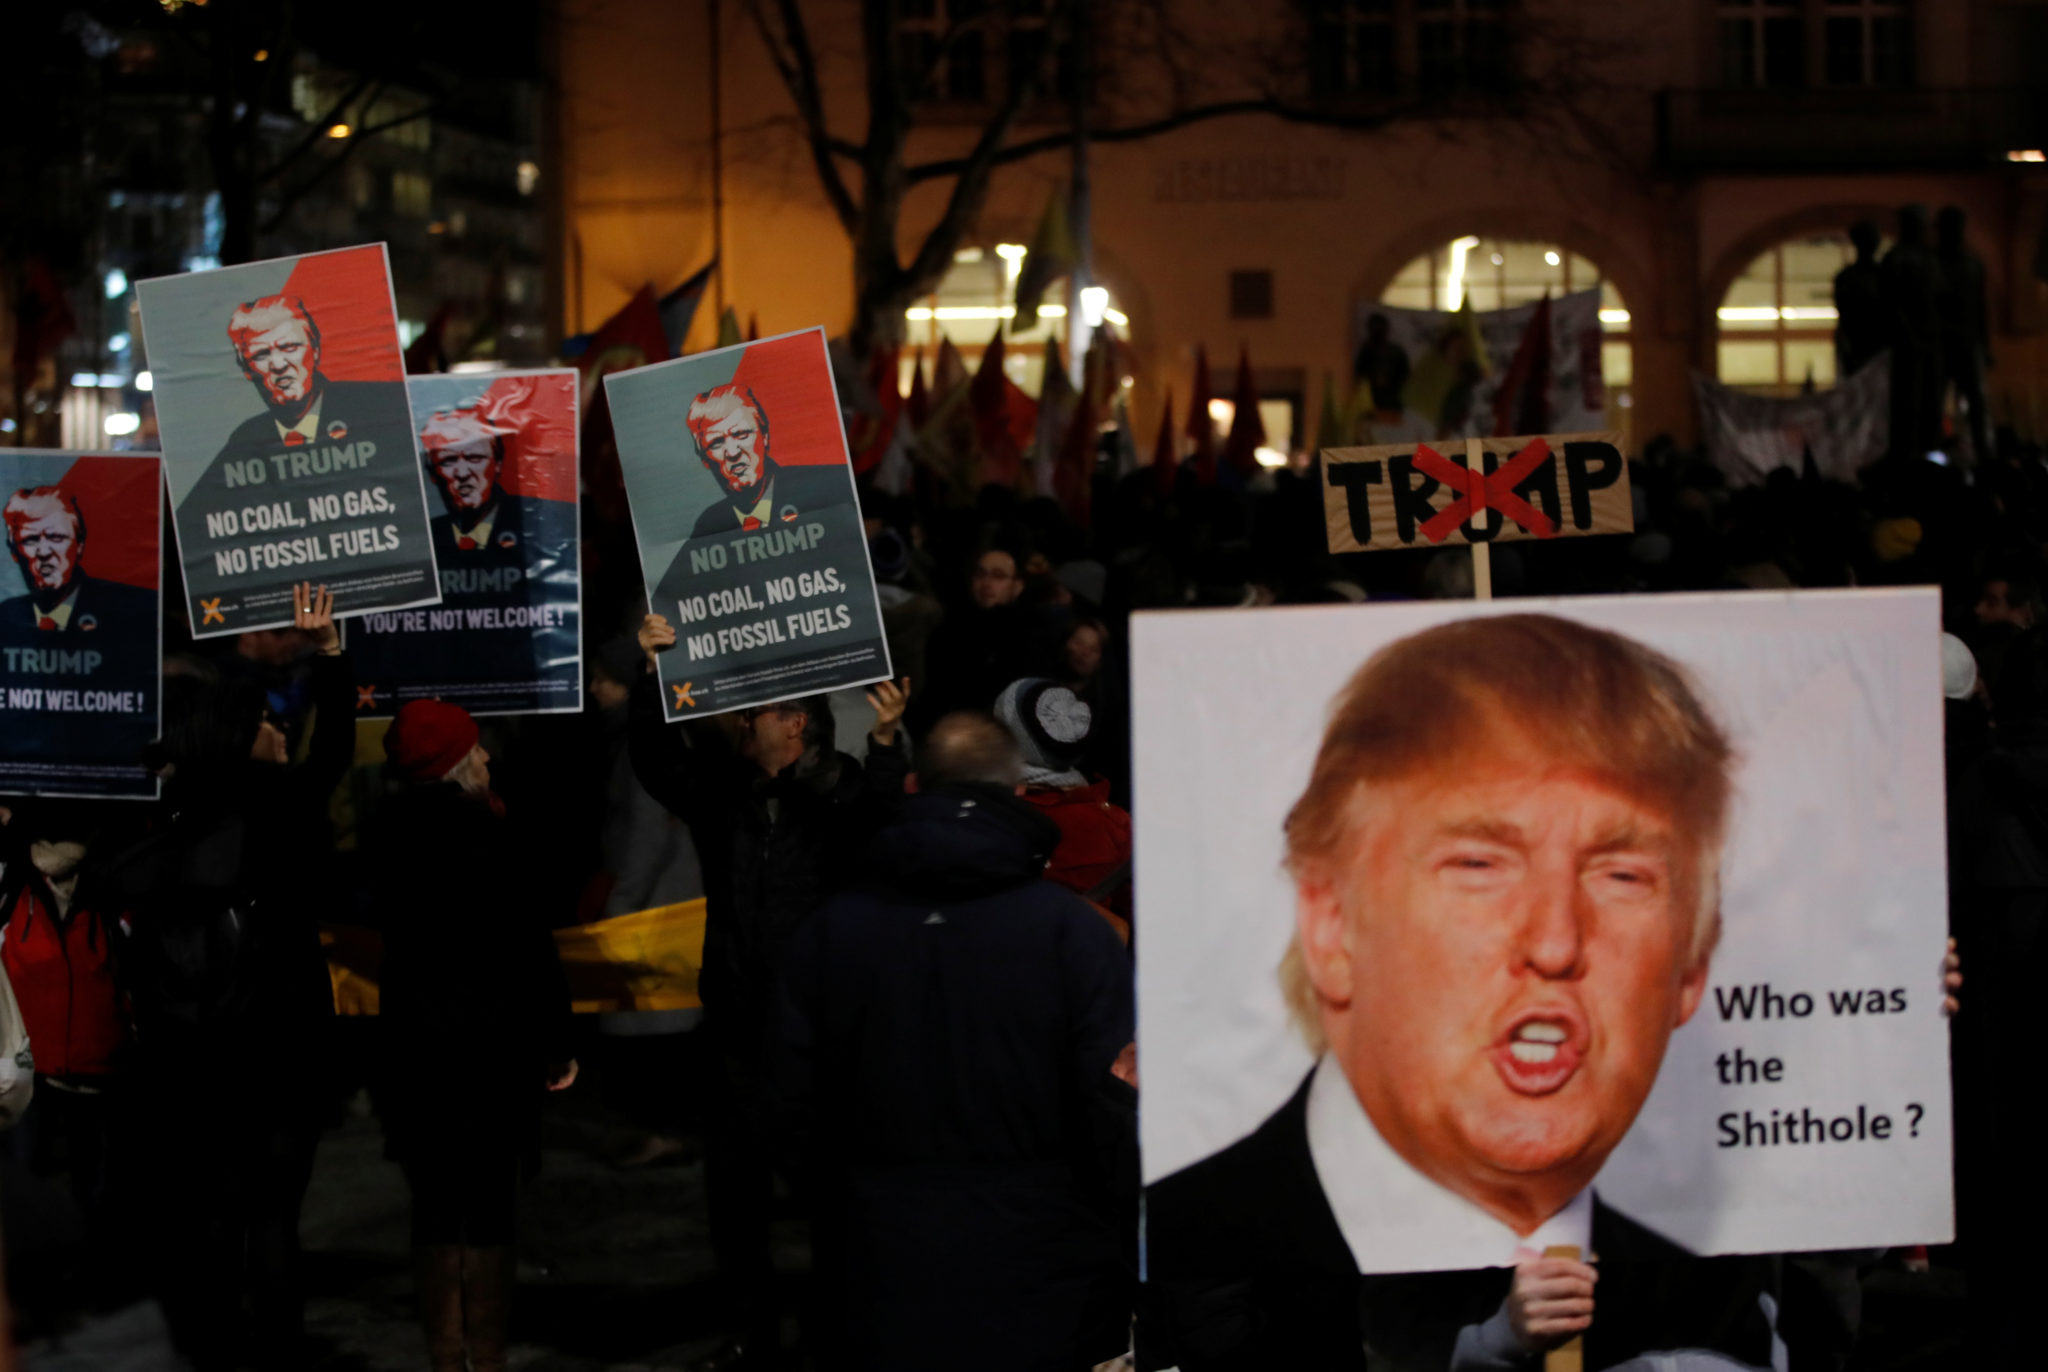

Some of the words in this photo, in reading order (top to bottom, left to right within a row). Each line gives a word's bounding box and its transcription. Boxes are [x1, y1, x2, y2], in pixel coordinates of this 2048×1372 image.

[223, 458, 267, 488] NO
[270, 441, 377, 480] TRUMP
[206, 510, 239, 538] NO
[241, 501, 306, 532] COAL,
[308, 494, 341, 522] NO
[343, 486, 396, 516] GAS,
[214, 548, 248, 577] NO
[249, 536, 327, 571] FOSSIL
[329, 524, 400, 559] FUELS
[690, 543, 728, 575] NO
[730, 522, 825, 565] TRUMP
[438, 567, 521, 594] RUMP
[678, 595, 707, 624] NO
[708, 585, 764, 618] COAL,
[765, 576, 797, 605] NO
[798, 567, 847, 598] GAS,
[362, 610, 427, 634] YOU'RE
[429, 608, 465, 631] NOT
[686, 632, 717, 661] NO
[717, 619, 787, 655] FOSSIL
[786, 604, 852, 637] FUELS
[3, 646, 103, 675] TRUMP
[8, 687, 43, 711] NOT
[1714, 984, 1814, 1021] Who
[1829, 988, 1907, 1016] was
[1716, 1049, 1784, 1084] the
[1717, 1104, 1892, 1148] Shithole
